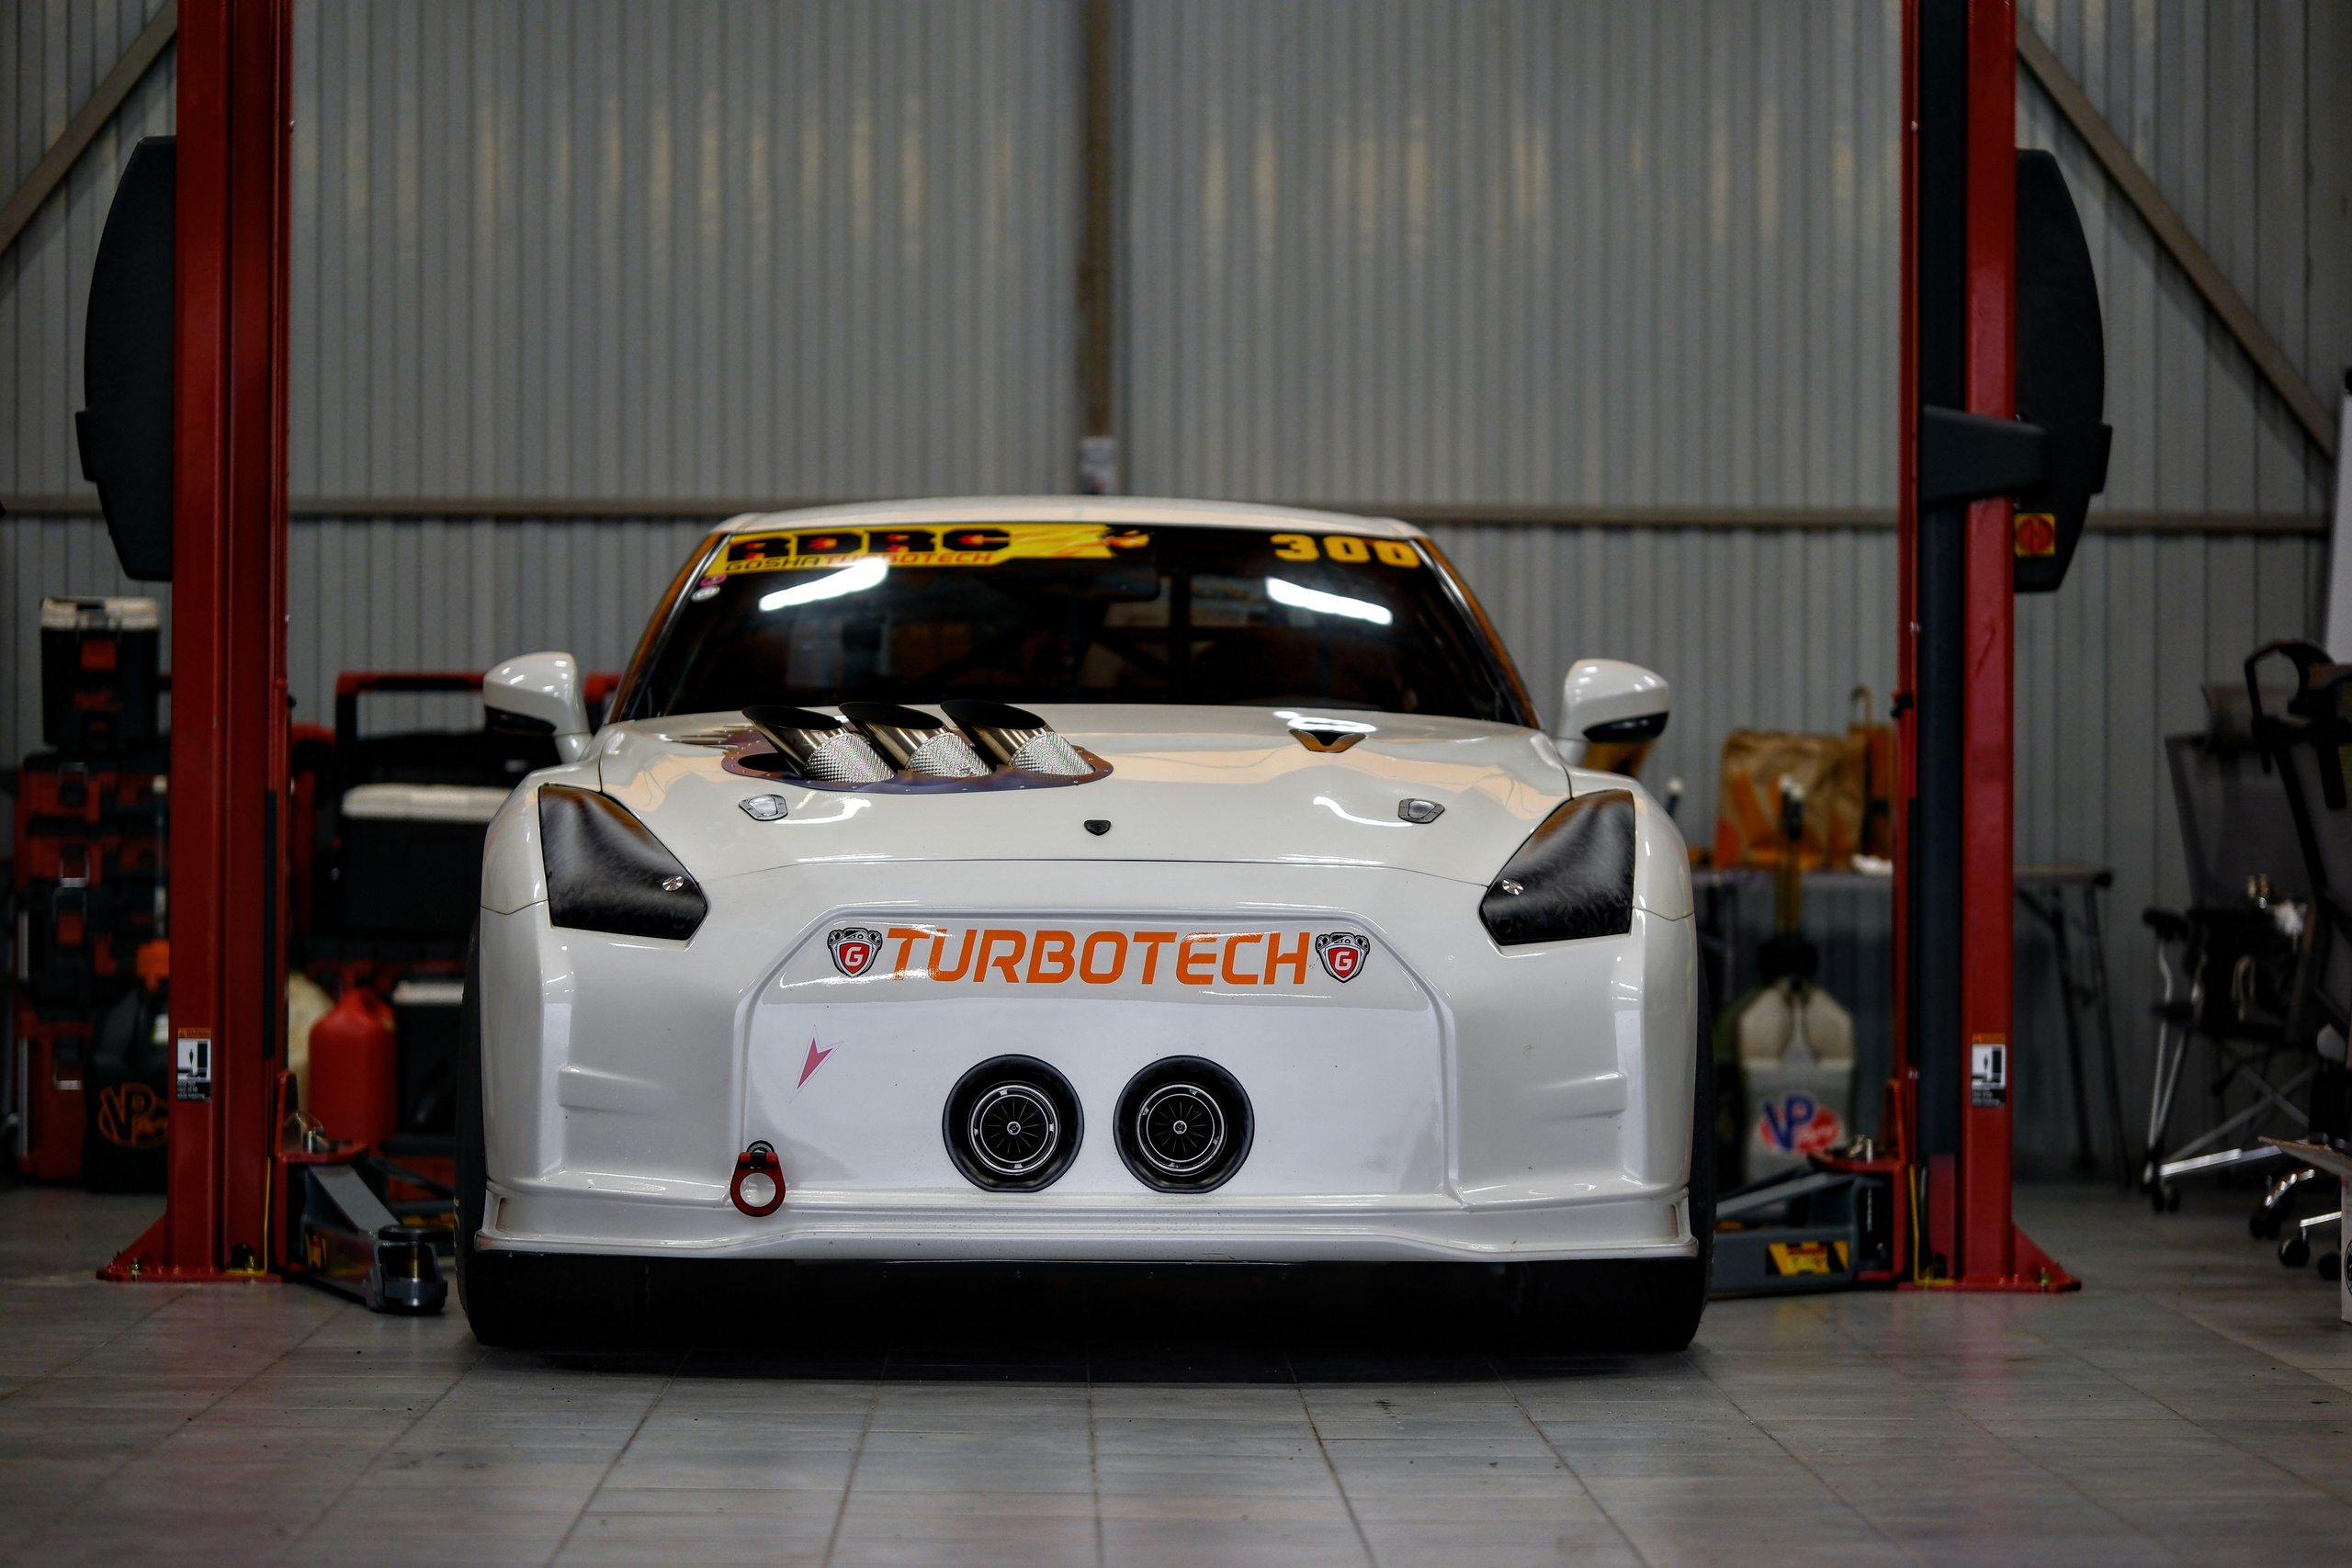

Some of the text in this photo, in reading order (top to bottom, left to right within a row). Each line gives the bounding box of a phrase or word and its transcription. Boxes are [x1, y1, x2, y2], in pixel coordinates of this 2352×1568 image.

[825, 552, 993, 565] TUBOTECH
[1270, 534, 1421, 568] 300
[844, 946, 864, 966] G
[887, 928, 1311, 985] TURBOTECH
[1334, 951, 1353, 971] G
[99, 1082, 156, 1145] VP
[1764, 1095, 1815, 1150] VP
